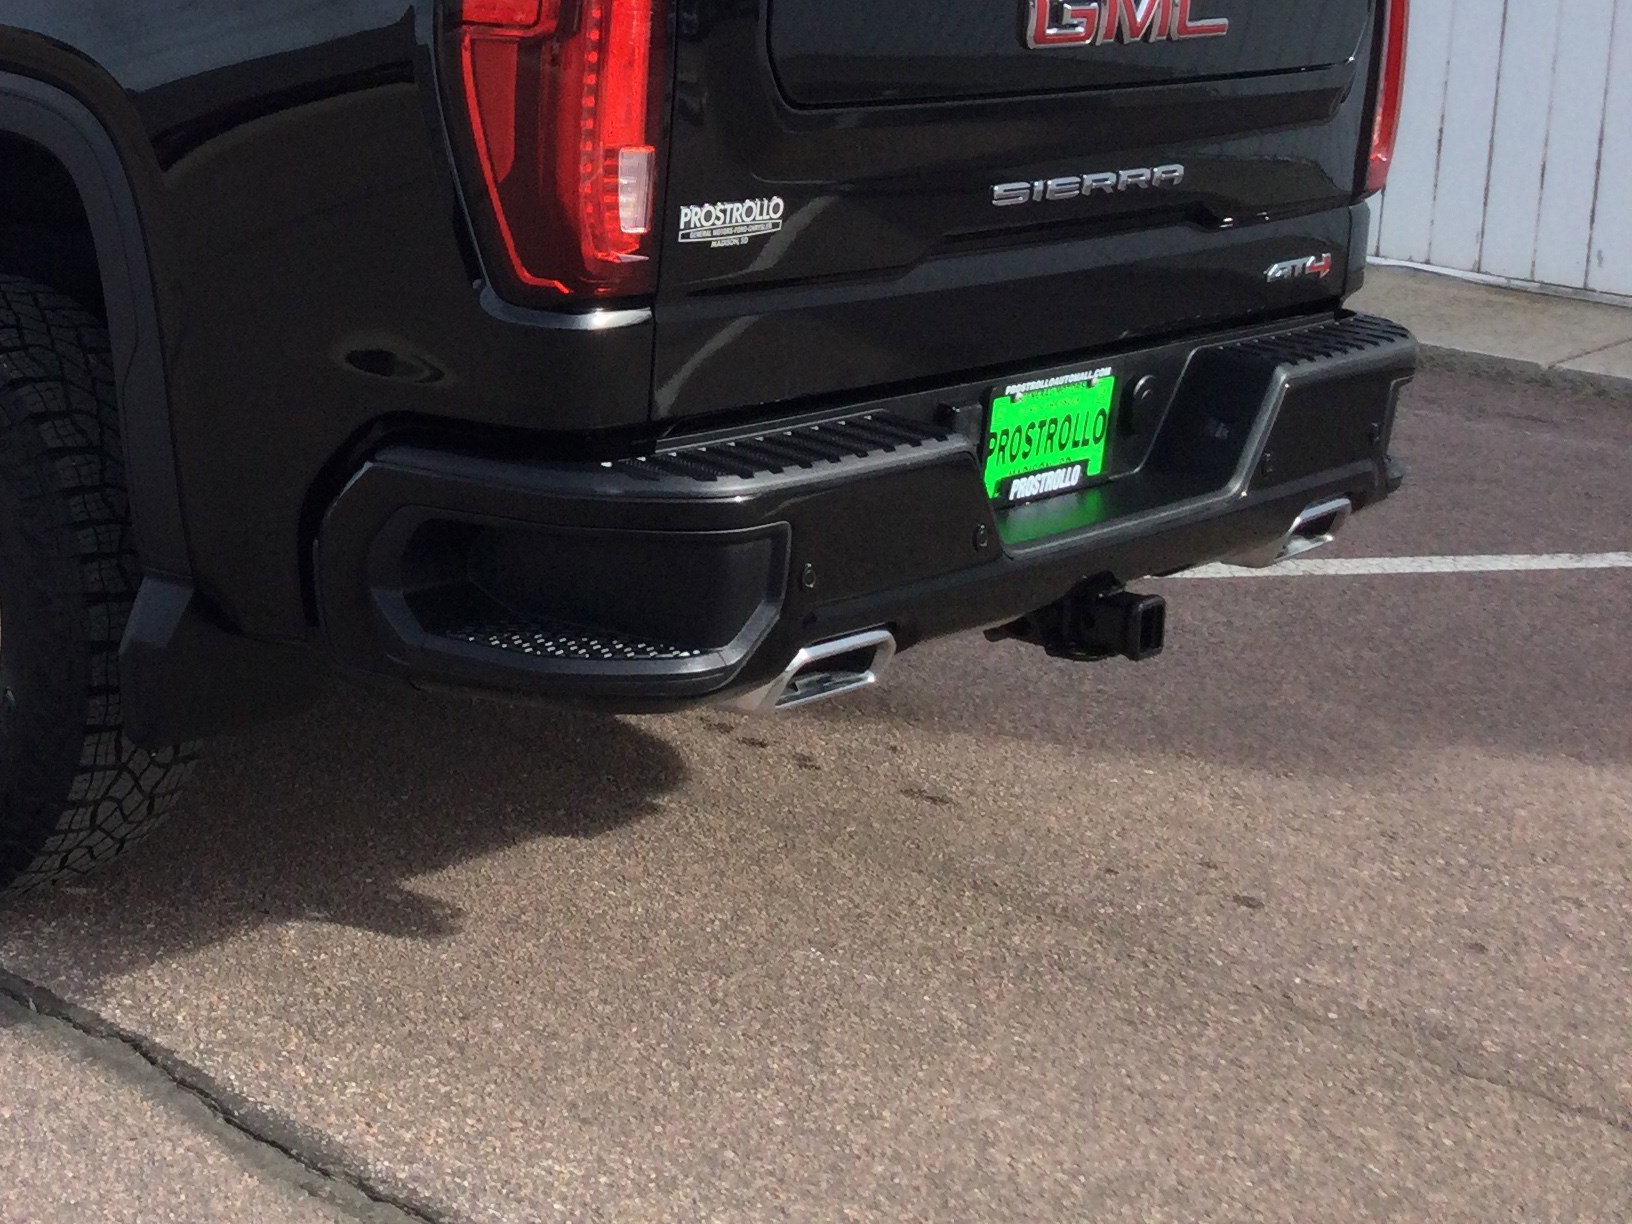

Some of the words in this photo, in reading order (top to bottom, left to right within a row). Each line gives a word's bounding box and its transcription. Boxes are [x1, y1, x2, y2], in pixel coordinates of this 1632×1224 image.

[991, 163, 1185, 207] SIERRA
[679, 196, 784, 229] PROSTROLLO
[1264, 253, 1331, 284] AT4
[988, 408, 1107, 467] PROSTROLLO
[1009, 465, 1082, 501] PROSTROLLO
